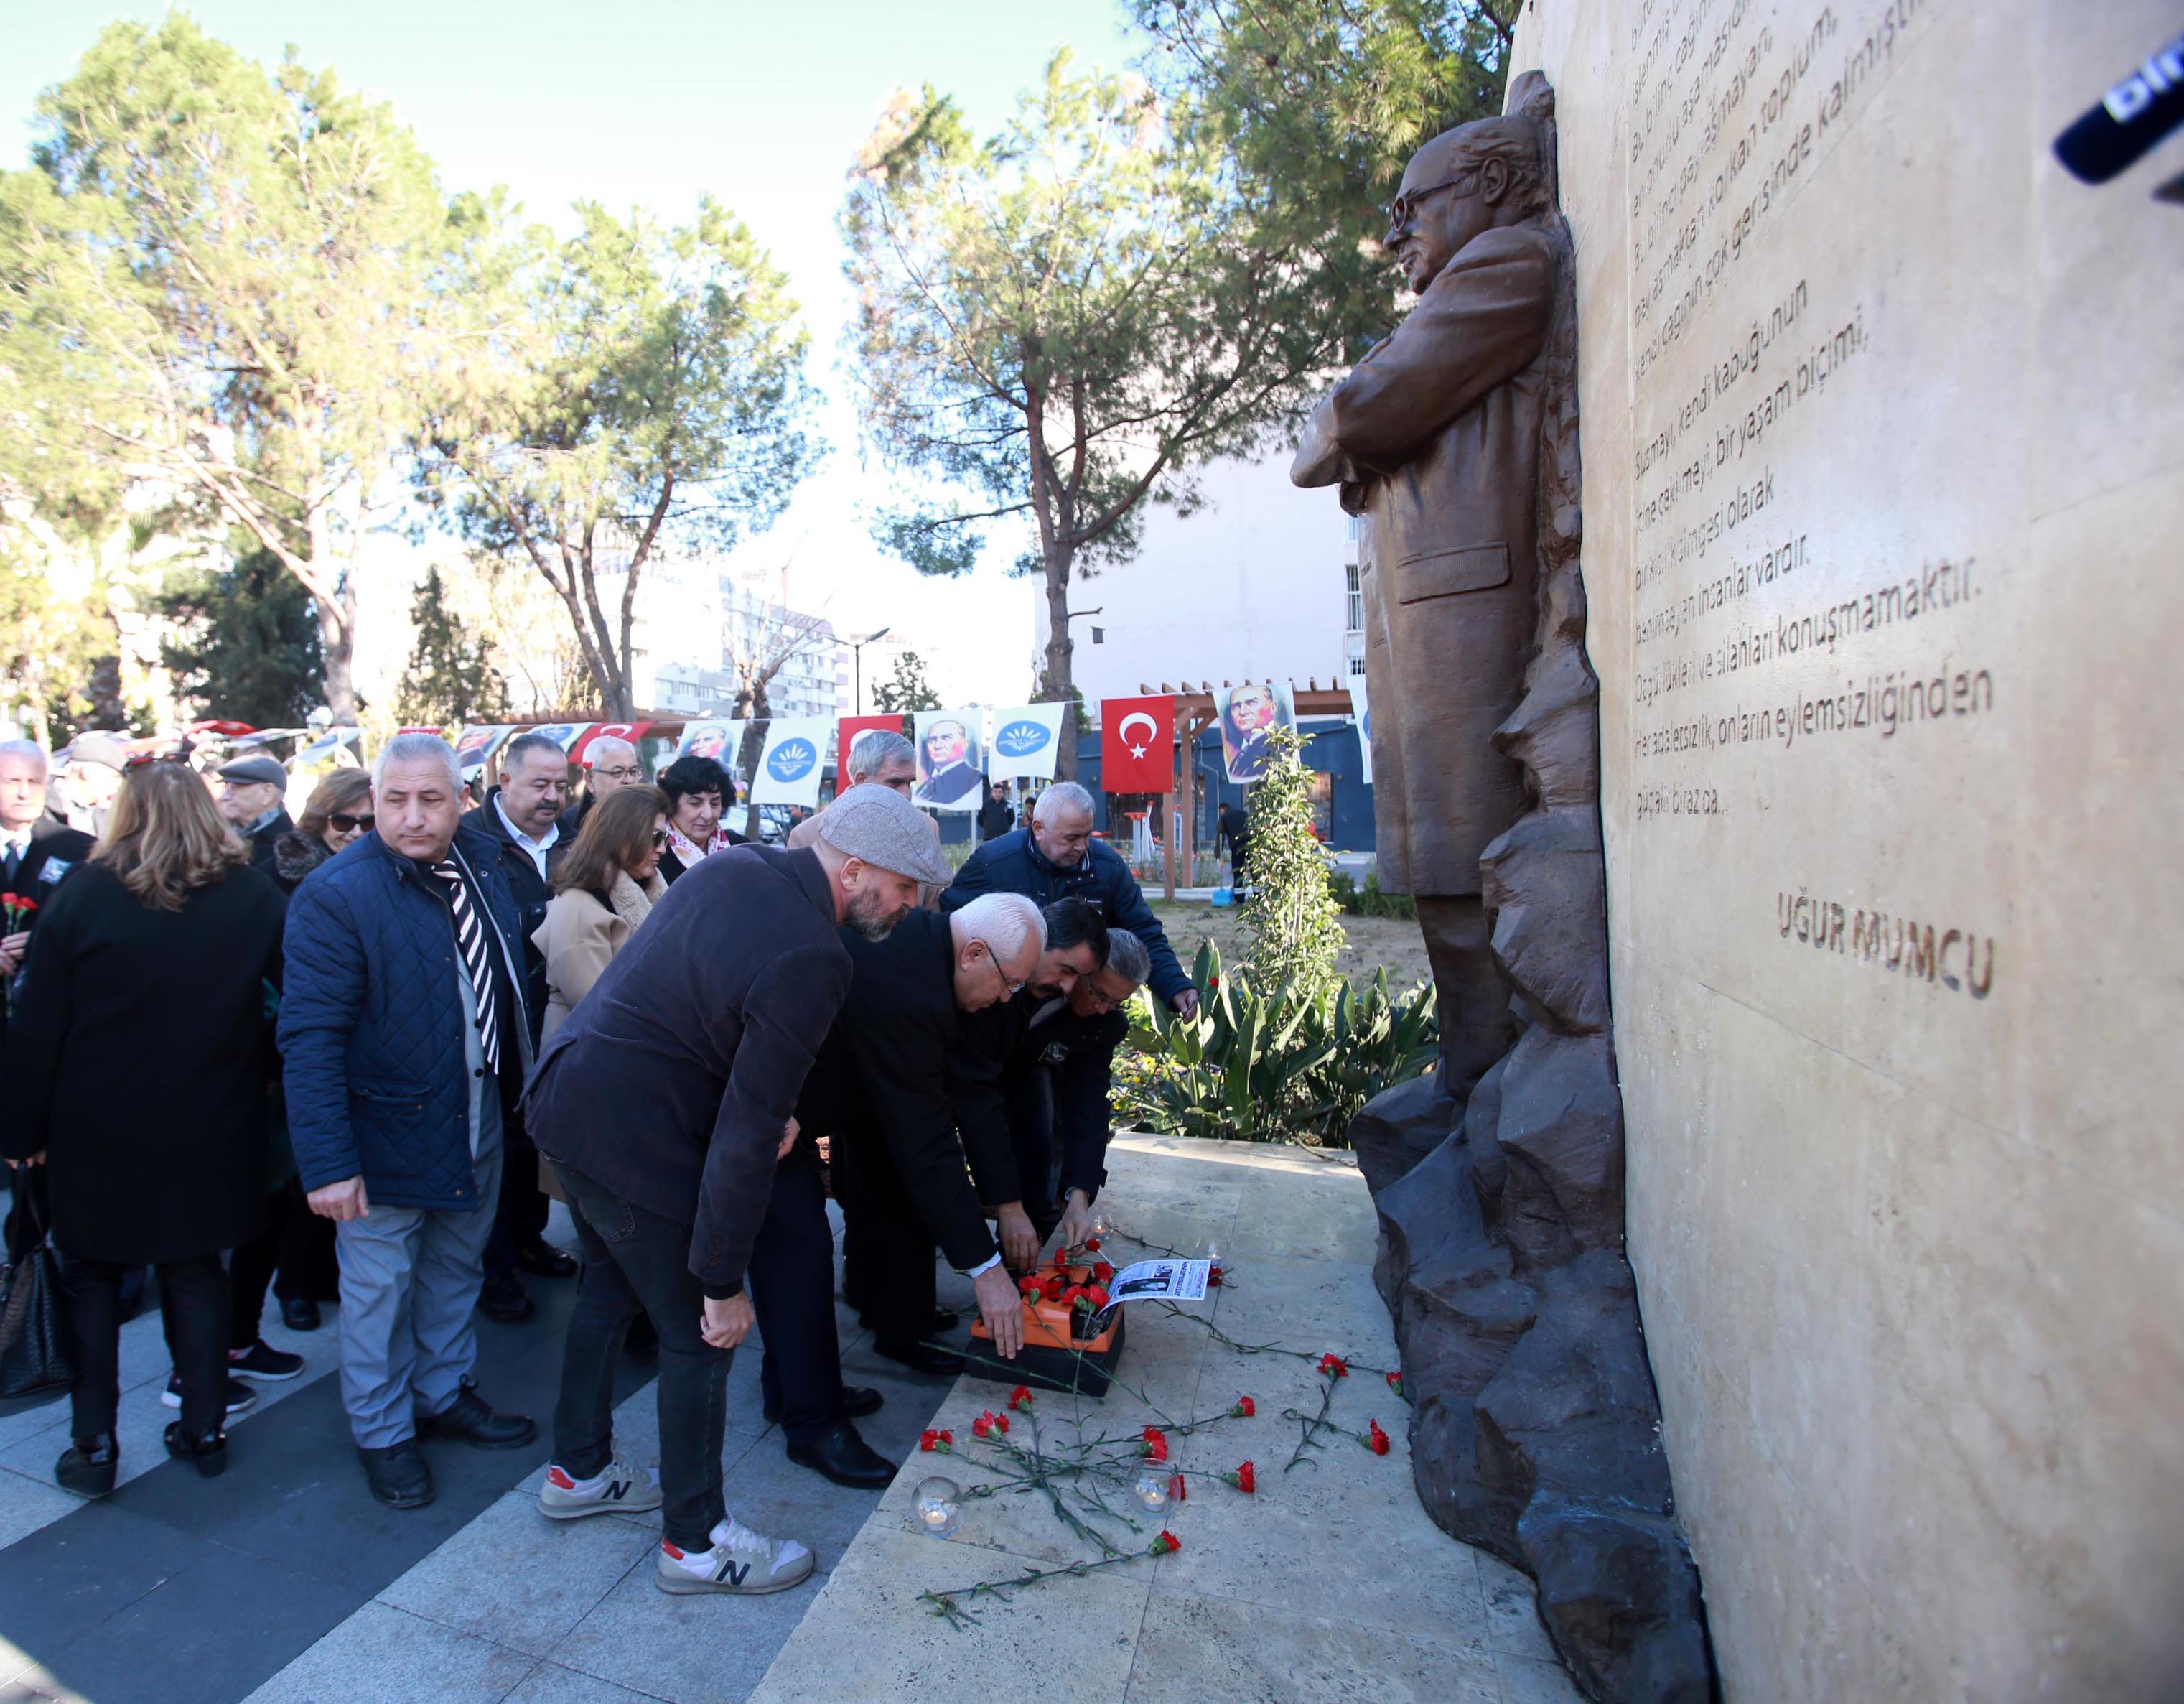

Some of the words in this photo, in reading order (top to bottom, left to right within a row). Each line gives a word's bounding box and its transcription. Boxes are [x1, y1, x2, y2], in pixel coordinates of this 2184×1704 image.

[1635, 204, 1704, 330] paylaşmaktan
[1760, 7, 1837, 134] toplum,
[1635, 323, 1660, 384] kendi
[1662, 275, 1702, 355] çağının
[1707, 231, 1729, 297] çok
[1732, 122, 1811, 261] gerisinde
[1635, 422, 1676, 480] Susmayı,
[1679, 373, 1711, 438] kendi
[1713, 279, 1808, 400] kabuğunun
[1635, 499, 1656, 541] içine
[1658, 442, 1714, 524] çekilmeyi,
[1717, 424, 1735, 467] bir
[1738, 379, 1791, 461] yaşam
[1796, 304, 1869, 400] biçimi,
[1636, 556, 1647, 591] bir
[1679, 500, 1724, 563] simgesi
[1727, 464, 1774, 529] olarak
[1698, 560, 1752, 616] insanlar
[1755, 527, 1811, 587] vardır.
[1699, 652, 1712, 682] ve
[1717, 623, 1773, 676] silahları
[1777, 555, 1982, 654] konuşmamaktır.
[1635, 728, 1651, 758] Her
[1652, 709, 1715, 755] adaletsizlik,
[1718, 703, 1770, 748] onların
[1775, 654, 1994, 749] eylemsizliğinden
[1672, 781, 1700, 815] biraz
[1777, 885, 1845, 954] UĞUR
[1851, 907, 1994, 999] MUMCU
